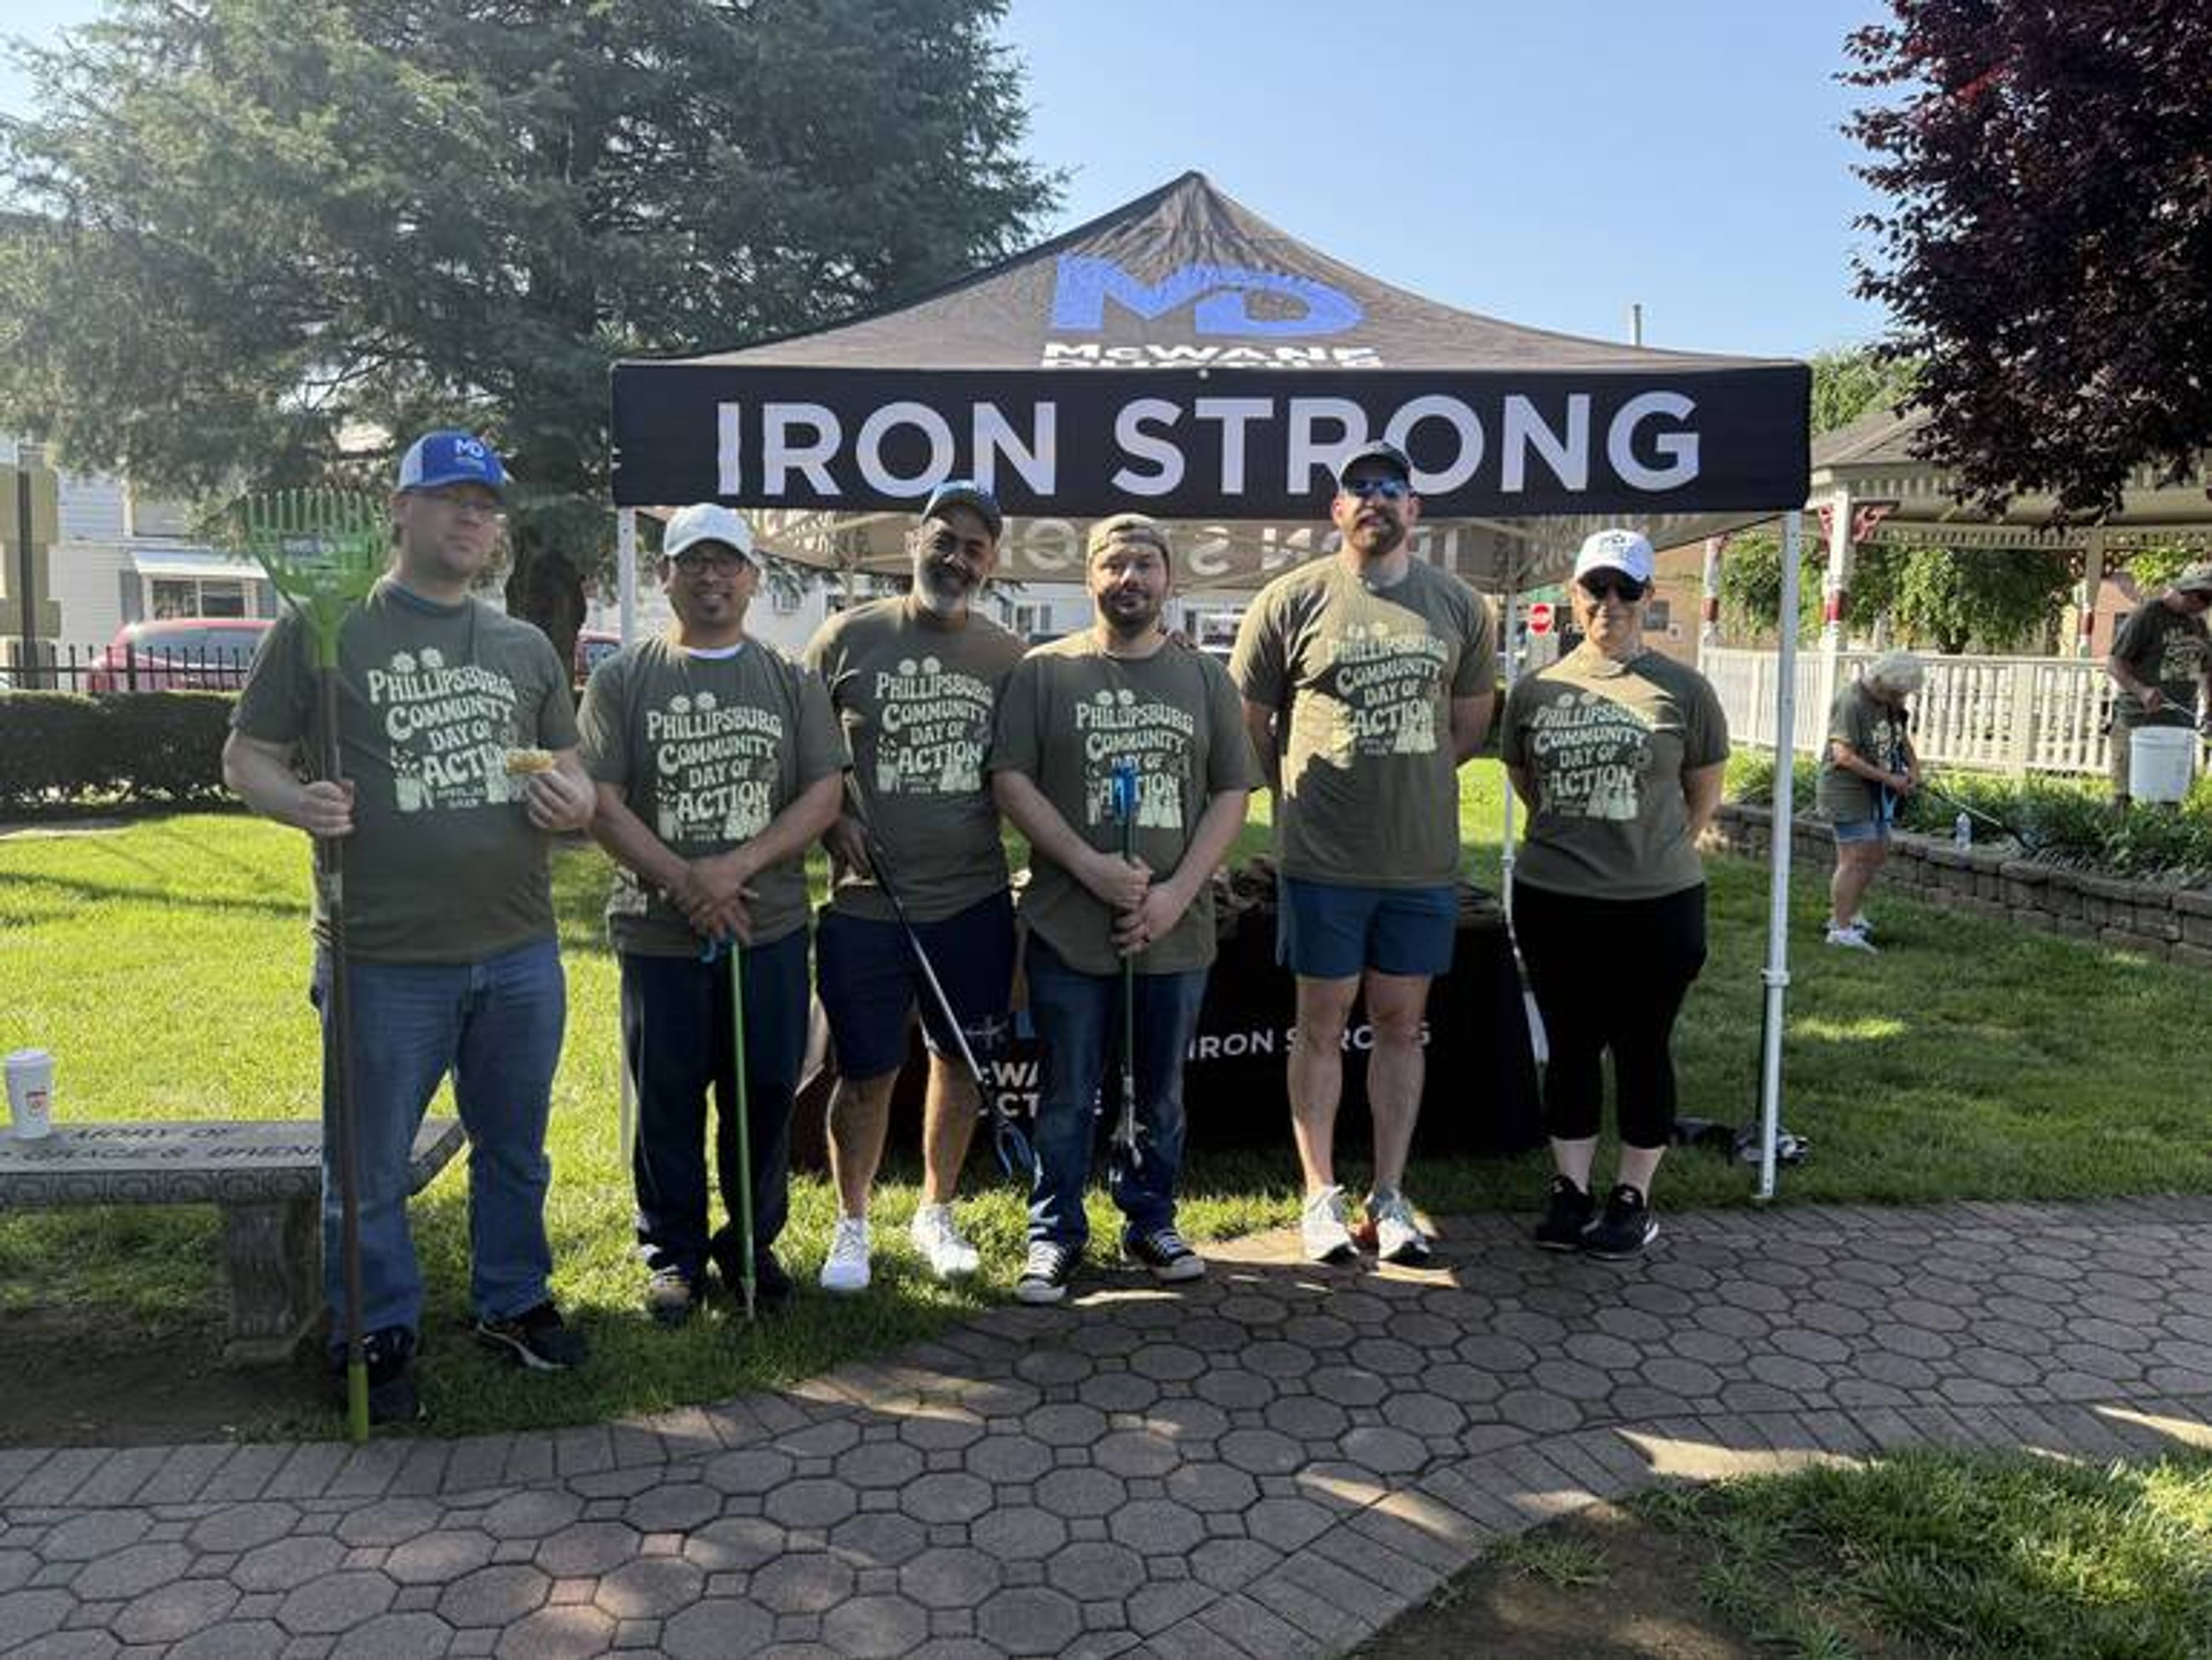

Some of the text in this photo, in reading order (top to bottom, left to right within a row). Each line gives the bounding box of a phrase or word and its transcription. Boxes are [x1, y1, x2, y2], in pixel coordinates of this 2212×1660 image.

[717, 391, 1700, 498] IRON STRONG
[1363, 679, 1421, 708] DAY OF
[646, 706, 783, 741] PHILLIPSBURG
[910, 720, 966, 745] DAY OF
[1354, 698, 1435, 737] ACTION
[428, 725, 469, 752] DAY
[657, 734, 776, 775] COMMUNITY
[1533, 726, 1647, 755] COMMUNITY
[898, 740, 983, 774] ACTION
[1143, 753, 1166, 770] OF
[1559, 744, 1619, 768] DAY OF
[689, 759, 752, 789] DAY OF
[1550, 764, 1636, 797] ACTION
[677, 780, 771, 823] ACTION
[1188, 1028, 1274, 1060] IRON
